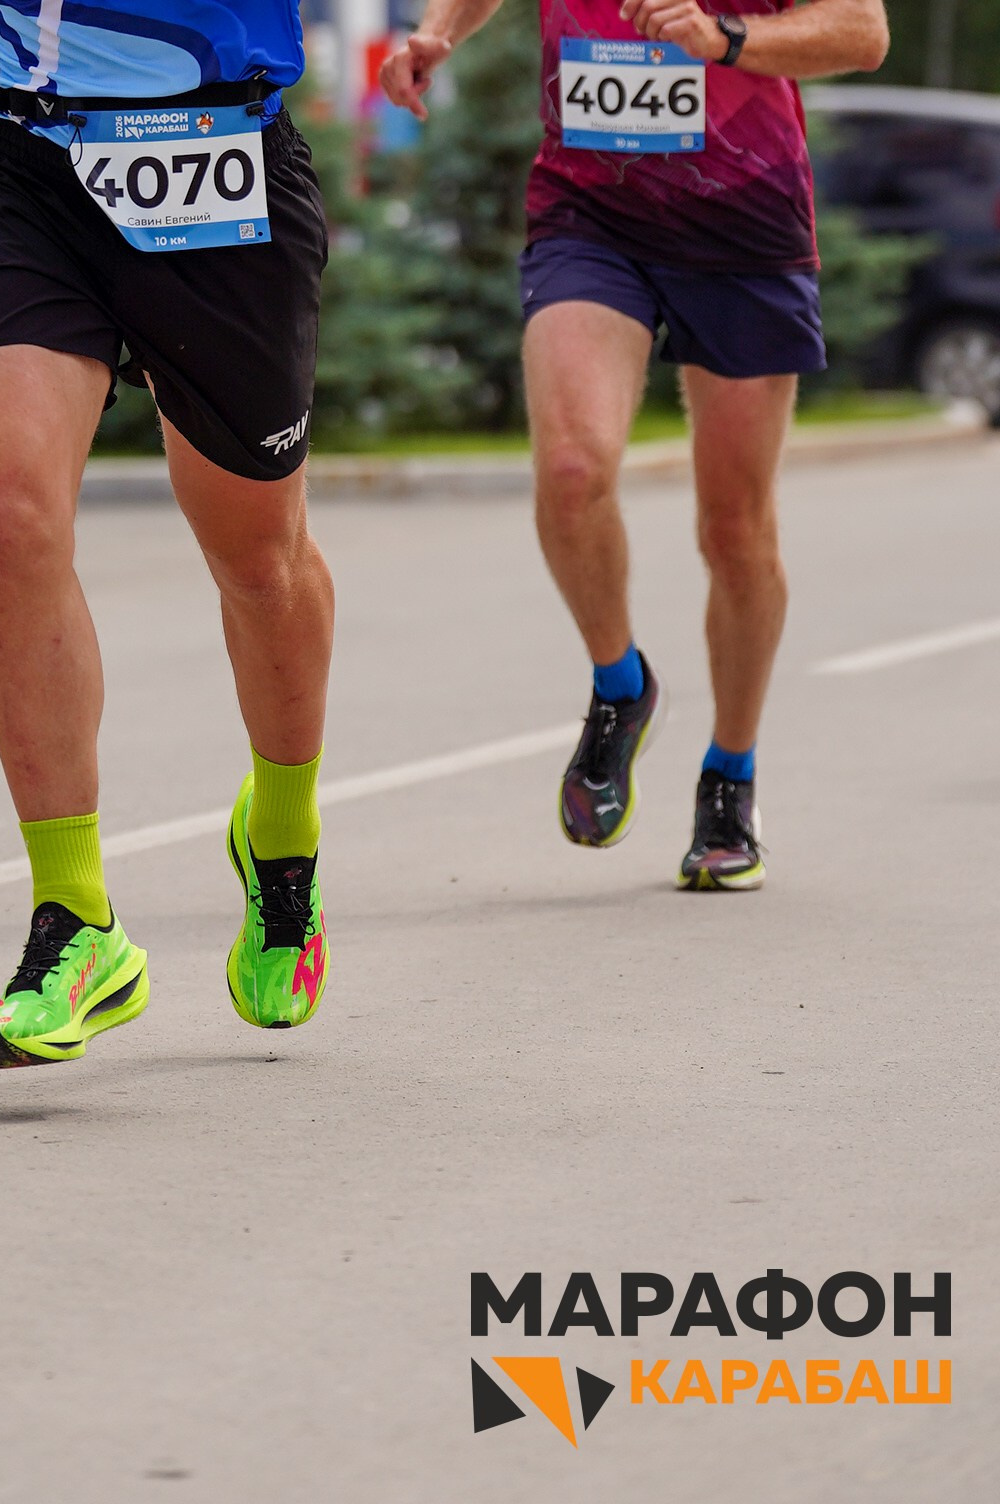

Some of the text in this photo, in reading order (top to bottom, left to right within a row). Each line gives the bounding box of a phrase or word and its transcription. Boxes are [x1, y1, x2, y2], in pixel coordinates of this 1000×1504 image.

[567, 75, 699, 118] 4046
[124, 112, 189, 125] МАРАФОН
[115, 115, 124, 138] 2026
[145, 124, 189, 134] КАРАБАШ
[85, 148, 255, 209] 4070
[127, 212, 211, 227] Савин Евгений
[154, 236, 187, 247] 10 км
